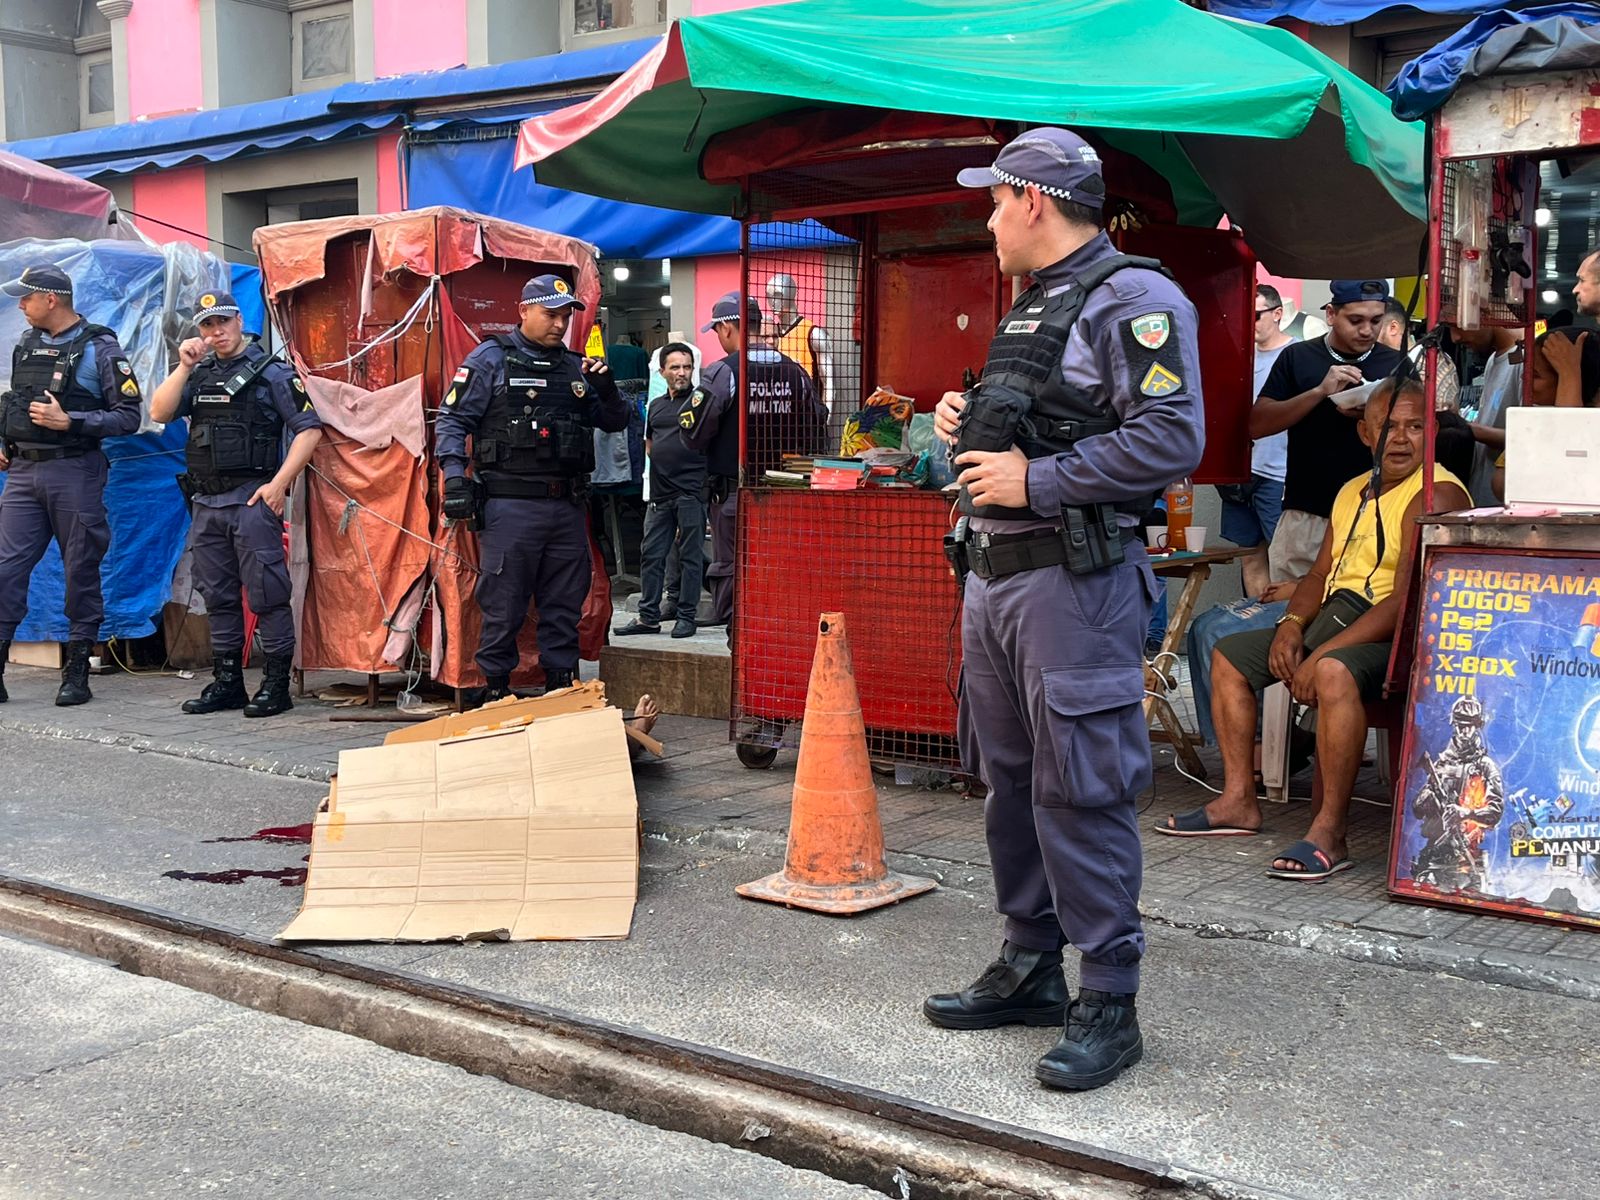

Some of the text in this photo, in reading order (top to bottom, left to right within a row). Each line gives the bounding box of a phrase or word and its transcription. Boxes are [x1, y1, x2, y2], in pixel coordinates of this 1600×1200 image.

[749, 400, 792, 414] MILITAR
[1442, 589, 1532, 613] JOGOS
[1440, 610, 1494, 632] Ps2
[1438, 632, 1473, 652] DS
[1435, 653, 1519, 678] X-BOX
[1532, 823, 1600, 839] COMPUT
